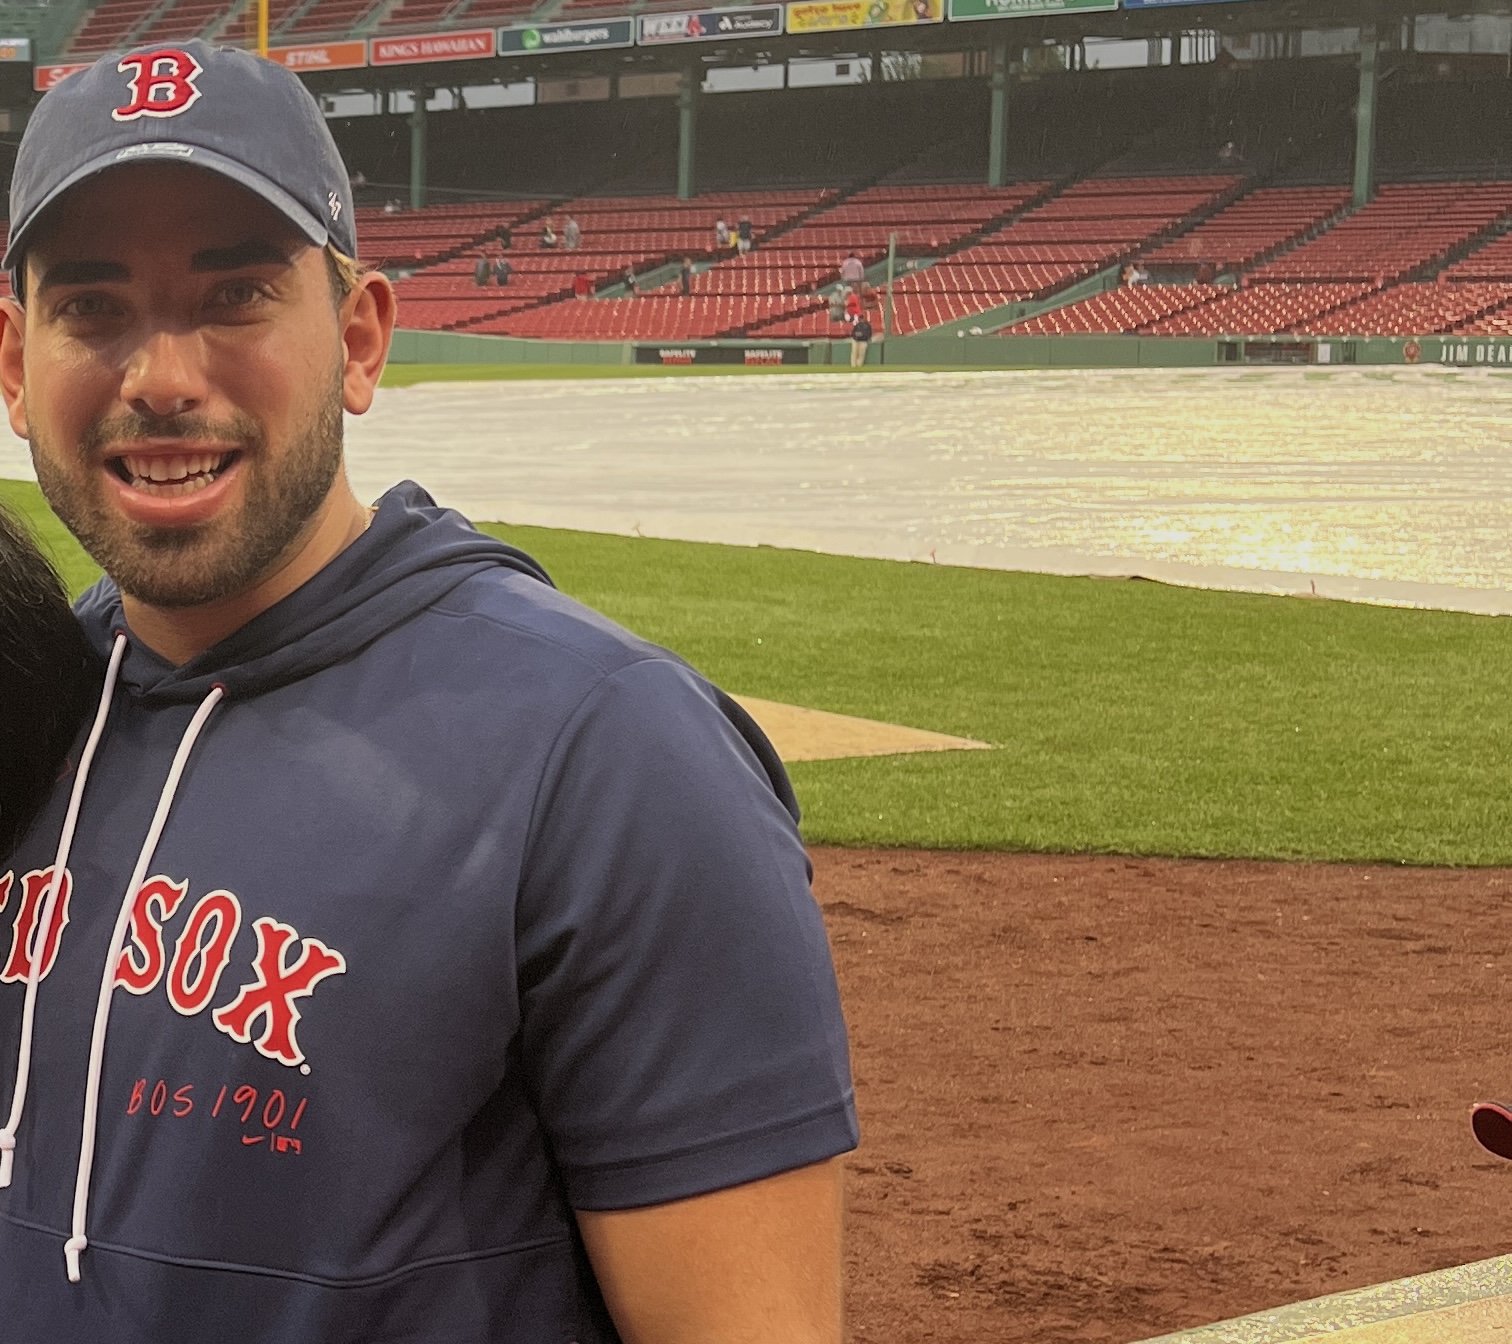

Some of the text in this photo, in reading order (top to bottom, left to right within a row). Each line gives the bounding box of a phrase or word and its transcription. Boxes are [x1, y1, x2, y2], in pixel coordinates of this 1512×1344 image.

[111, 48, 204, 122] B
[1440, 344, 1512, 363] JIM DEA
[112, 874, 347, 1067] SOX
[126, 1078, 308, 1130] BOS 1901
